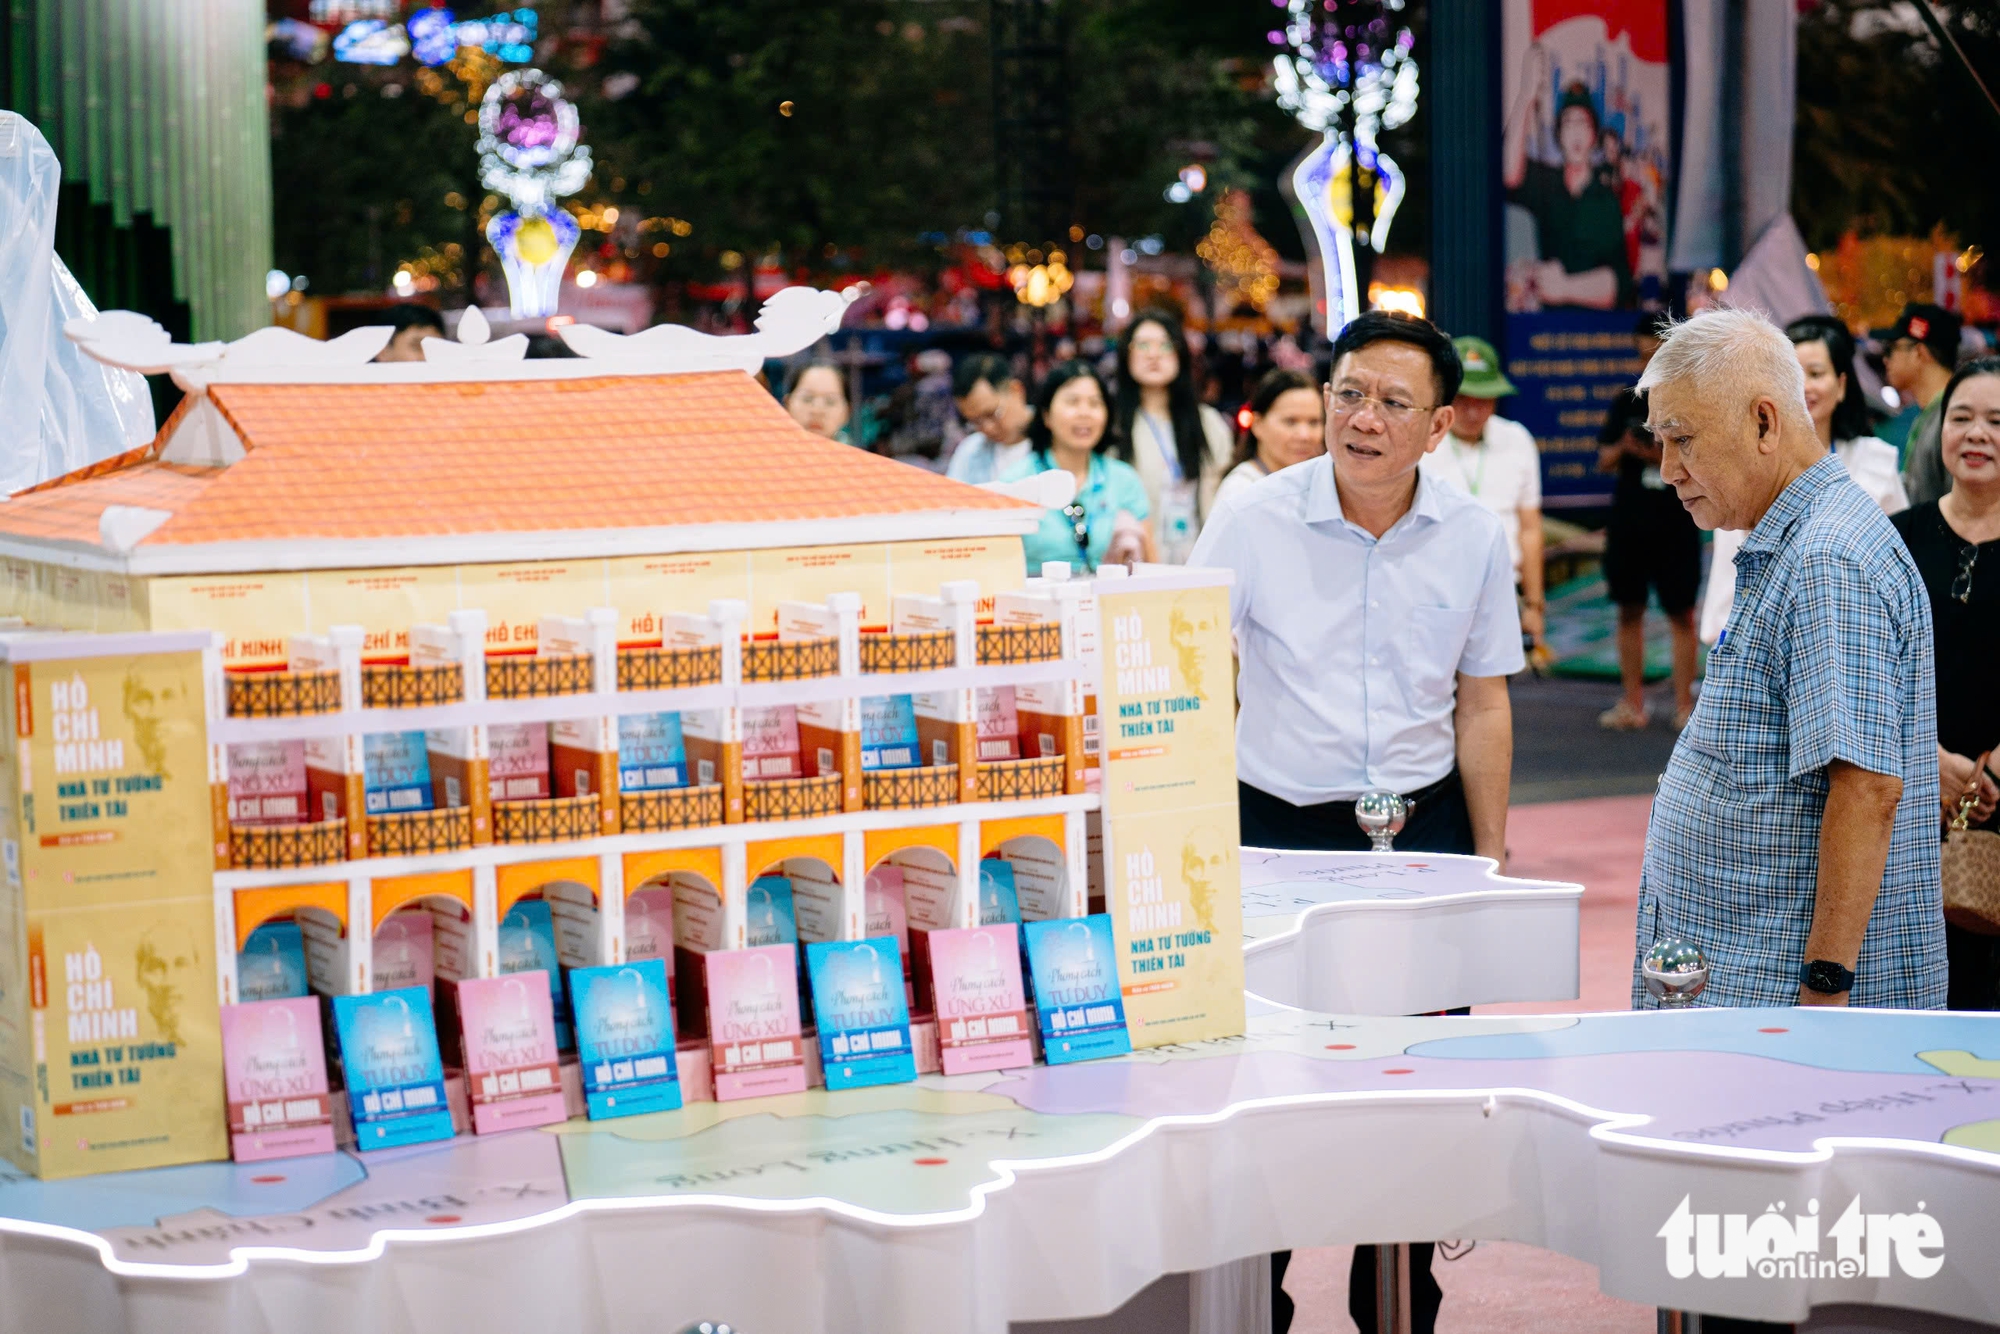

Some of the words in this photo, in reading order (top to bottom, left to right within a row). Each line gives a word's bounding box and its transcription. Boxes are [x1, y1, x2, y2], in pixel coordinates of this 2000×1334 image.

[974, 597, 994, 612] INH
[486, 620, 508, 642] HỒ
[1113, 606, 1142, 641] HỒ
[222, 637, 236, 657] HÍ
[241, 638, 282, 657] MINH
[1115, 639, 1150, 668] CHÍ
[51, 669, 88, 710] HỒ
[1117, 666, 1170, 695] MINH
[1119, 703, 1143, 718] NHÀ
[1147, 699, 1161, 715] TƯ
[1165, 695, 1200, 712] TƯỞNG
[53, 706, 99, 741] CHÍ
[1121, 722, 1154, 738] THIÊN
[1156, 719, 1174, 733] TÀI
[55, 738, 124, 773] MINH
[58, 779, 87, 799] NHÀ
[93, 778, 110, 797] TƯ
[115, 774, 163, 793] TƯỞNG
[59, 801, 100, 823] THIÊN
[105, 799, 128, 818] TÀI
[1126, 843, 1155, 878] HỒ
[1128, 873, 1163, 904] CHÍ
[1129, 900, 1182, 932] MINH
[1131, 937, 1154, 954] NHÀ
[1157, 934, 1172, 951] TƯ
[1176, 928, 1211, 947] TƯỞNG
[65, 941, 102, 983] HỒ
[1131, 956, 1163, 974] THIÊN
[1168, 952, 1185, 968] TÀI
[67, 977, 112, 1012] CHÍ
[948, 996, 985, 1016] ỨNG
[988, 990, 1013, 1011] XỬ
[1048, 988, 1073, 1006] TƯ
[1076, 983, 1108, 1001] DUY
[69, 1008, 138, 1043] MINH
[722, 1020, 760, 1040] ỨNG
[764, 1015, 789, 1035] XỬ
[830, 1013, 855, 1031] TƯ
[859, 1008, 895, 1027] DUY
[70, 1048, 100, 1068] NHÀ
[105, 1047, 124, 1066] TƯ
[128, 1042, 176, 1063] TƯỞNG
[72, 1070, 113, 1090] THIÊN
[118, 1067, 141, 1087] TÀI
